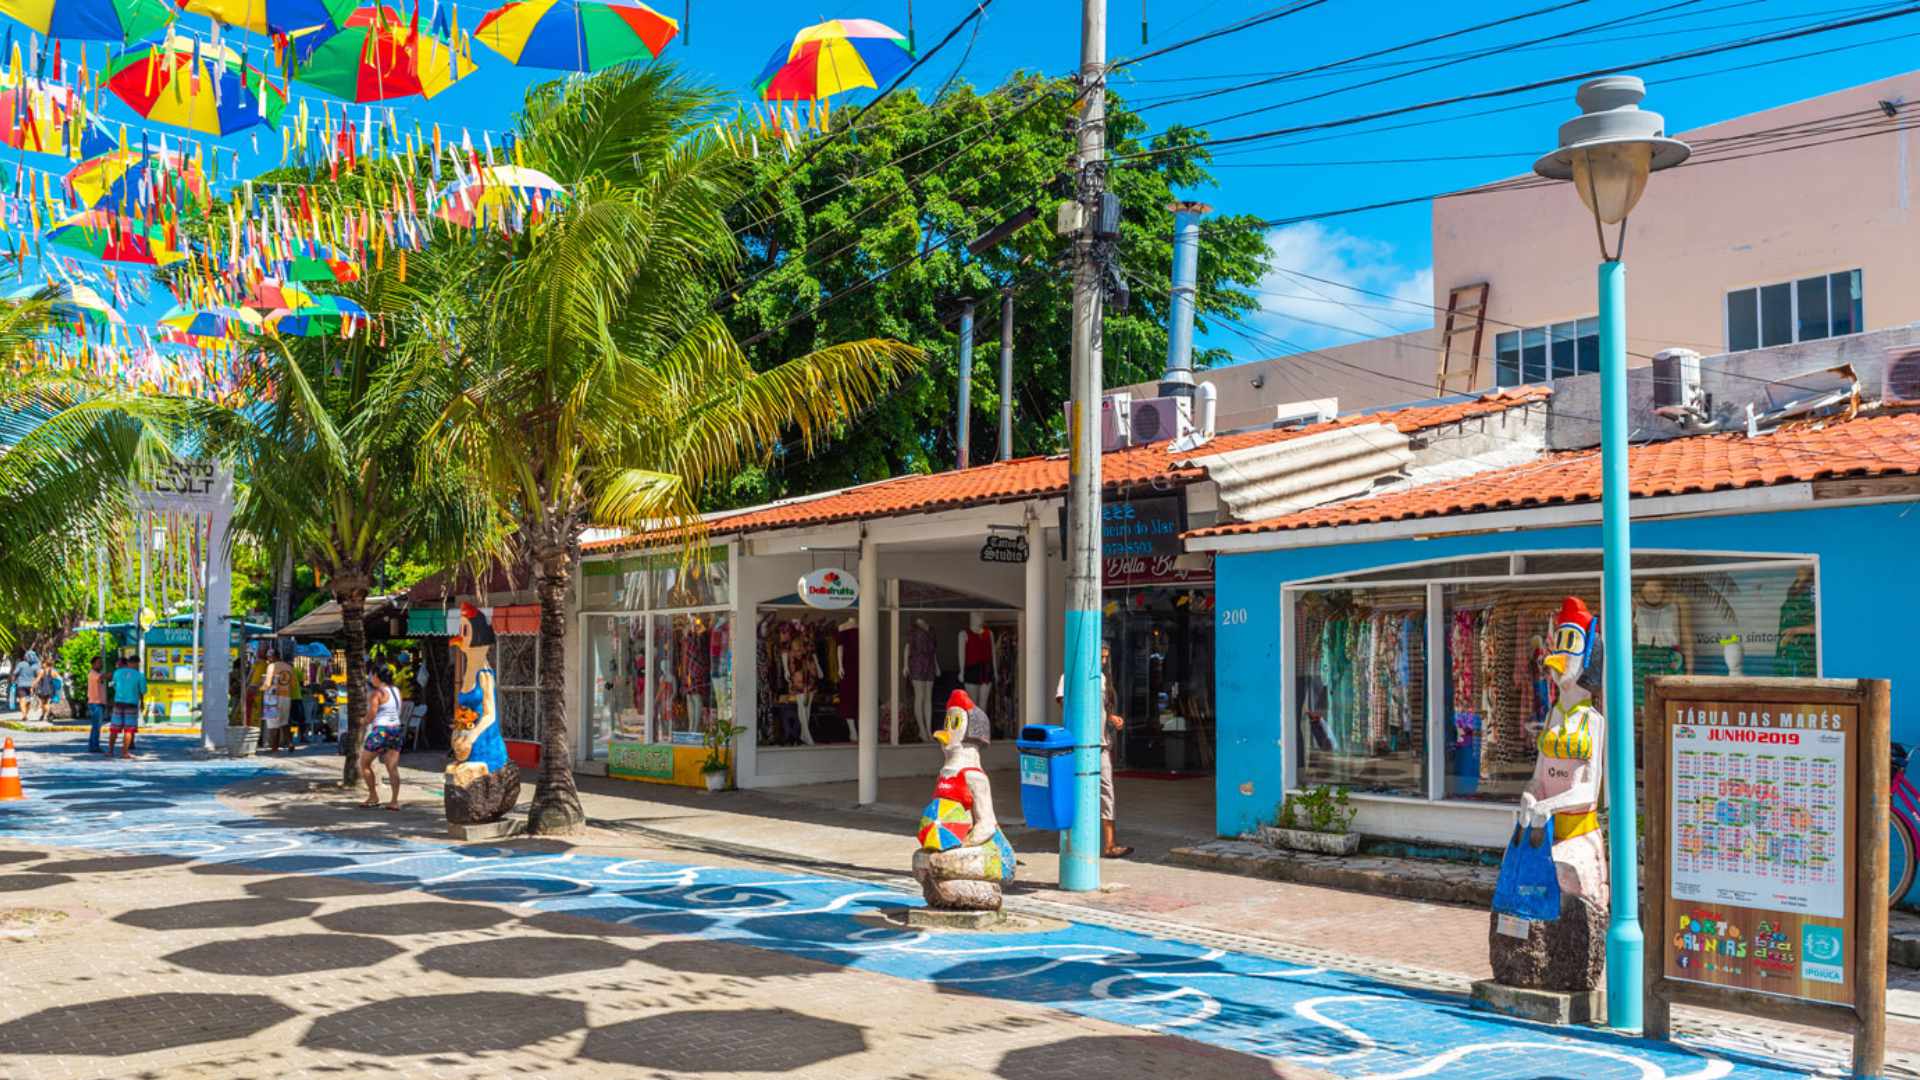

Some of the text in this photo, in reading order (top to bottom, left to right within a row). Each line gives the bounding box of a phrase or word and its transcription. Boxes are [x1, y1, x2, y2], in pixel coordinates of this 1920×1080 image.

[983, 546, 1023, 560] Studio
[1106, 556, 1147, 577] Della
[1222, 608, 1248, 625] 200
[1677, 707, 1841, 729] TÁBUA DAS MARÉS
[1707, 729, 1756, 743] JUNHO
[1757, 731, 1800, 745] 2019
